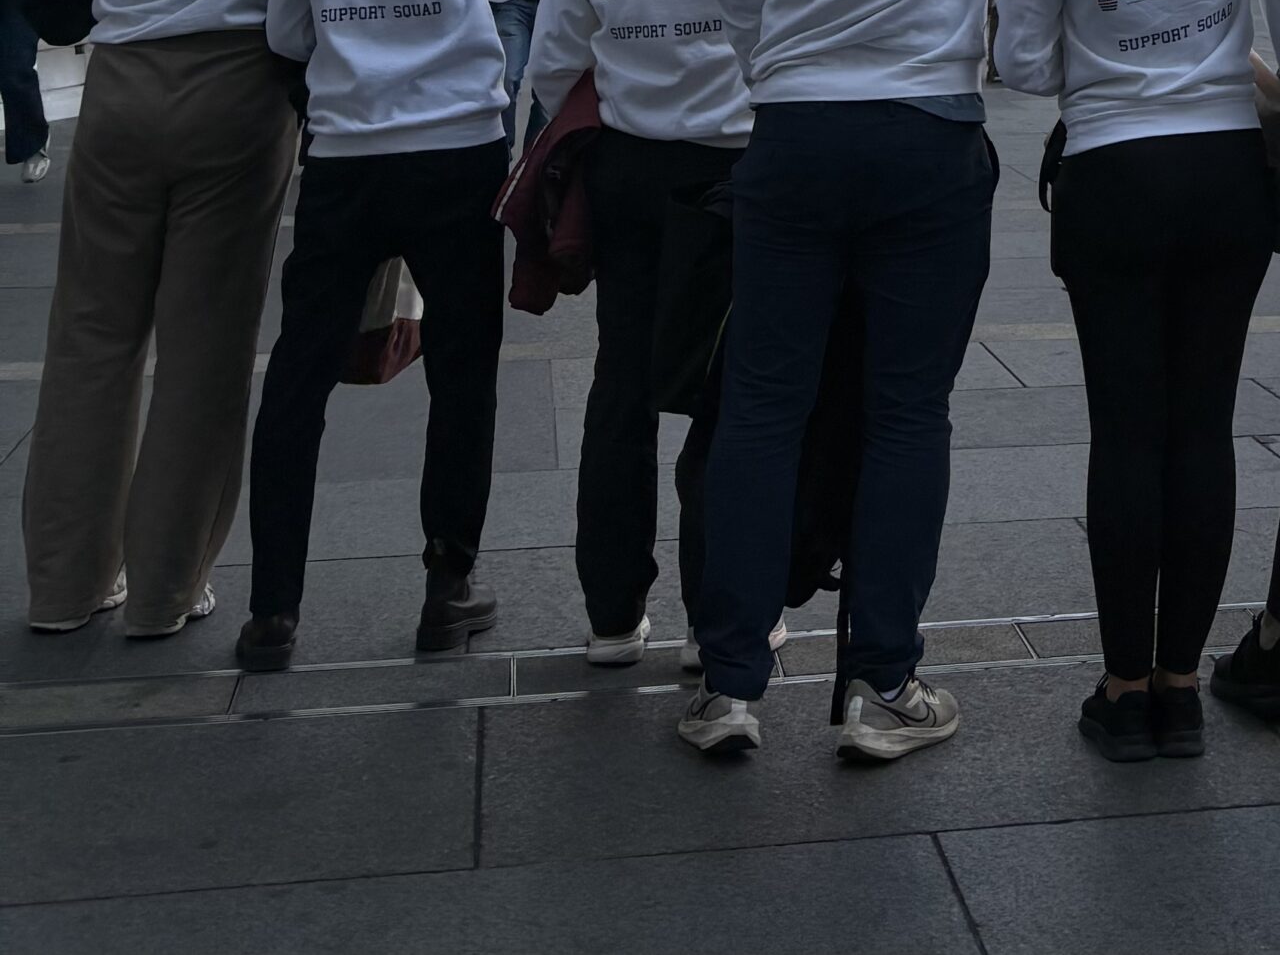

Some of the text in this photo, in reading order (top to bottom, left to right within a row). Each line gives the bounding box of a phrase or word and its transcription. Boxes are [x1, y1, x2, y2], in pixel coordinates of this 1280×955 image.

[321, 1, 442, 23] SUPPORT SQUAD
[610, 19, 723, 40] SUPPORT SQUAD
[1118, 1, 1233, 52] SUPPORT SQUAD
